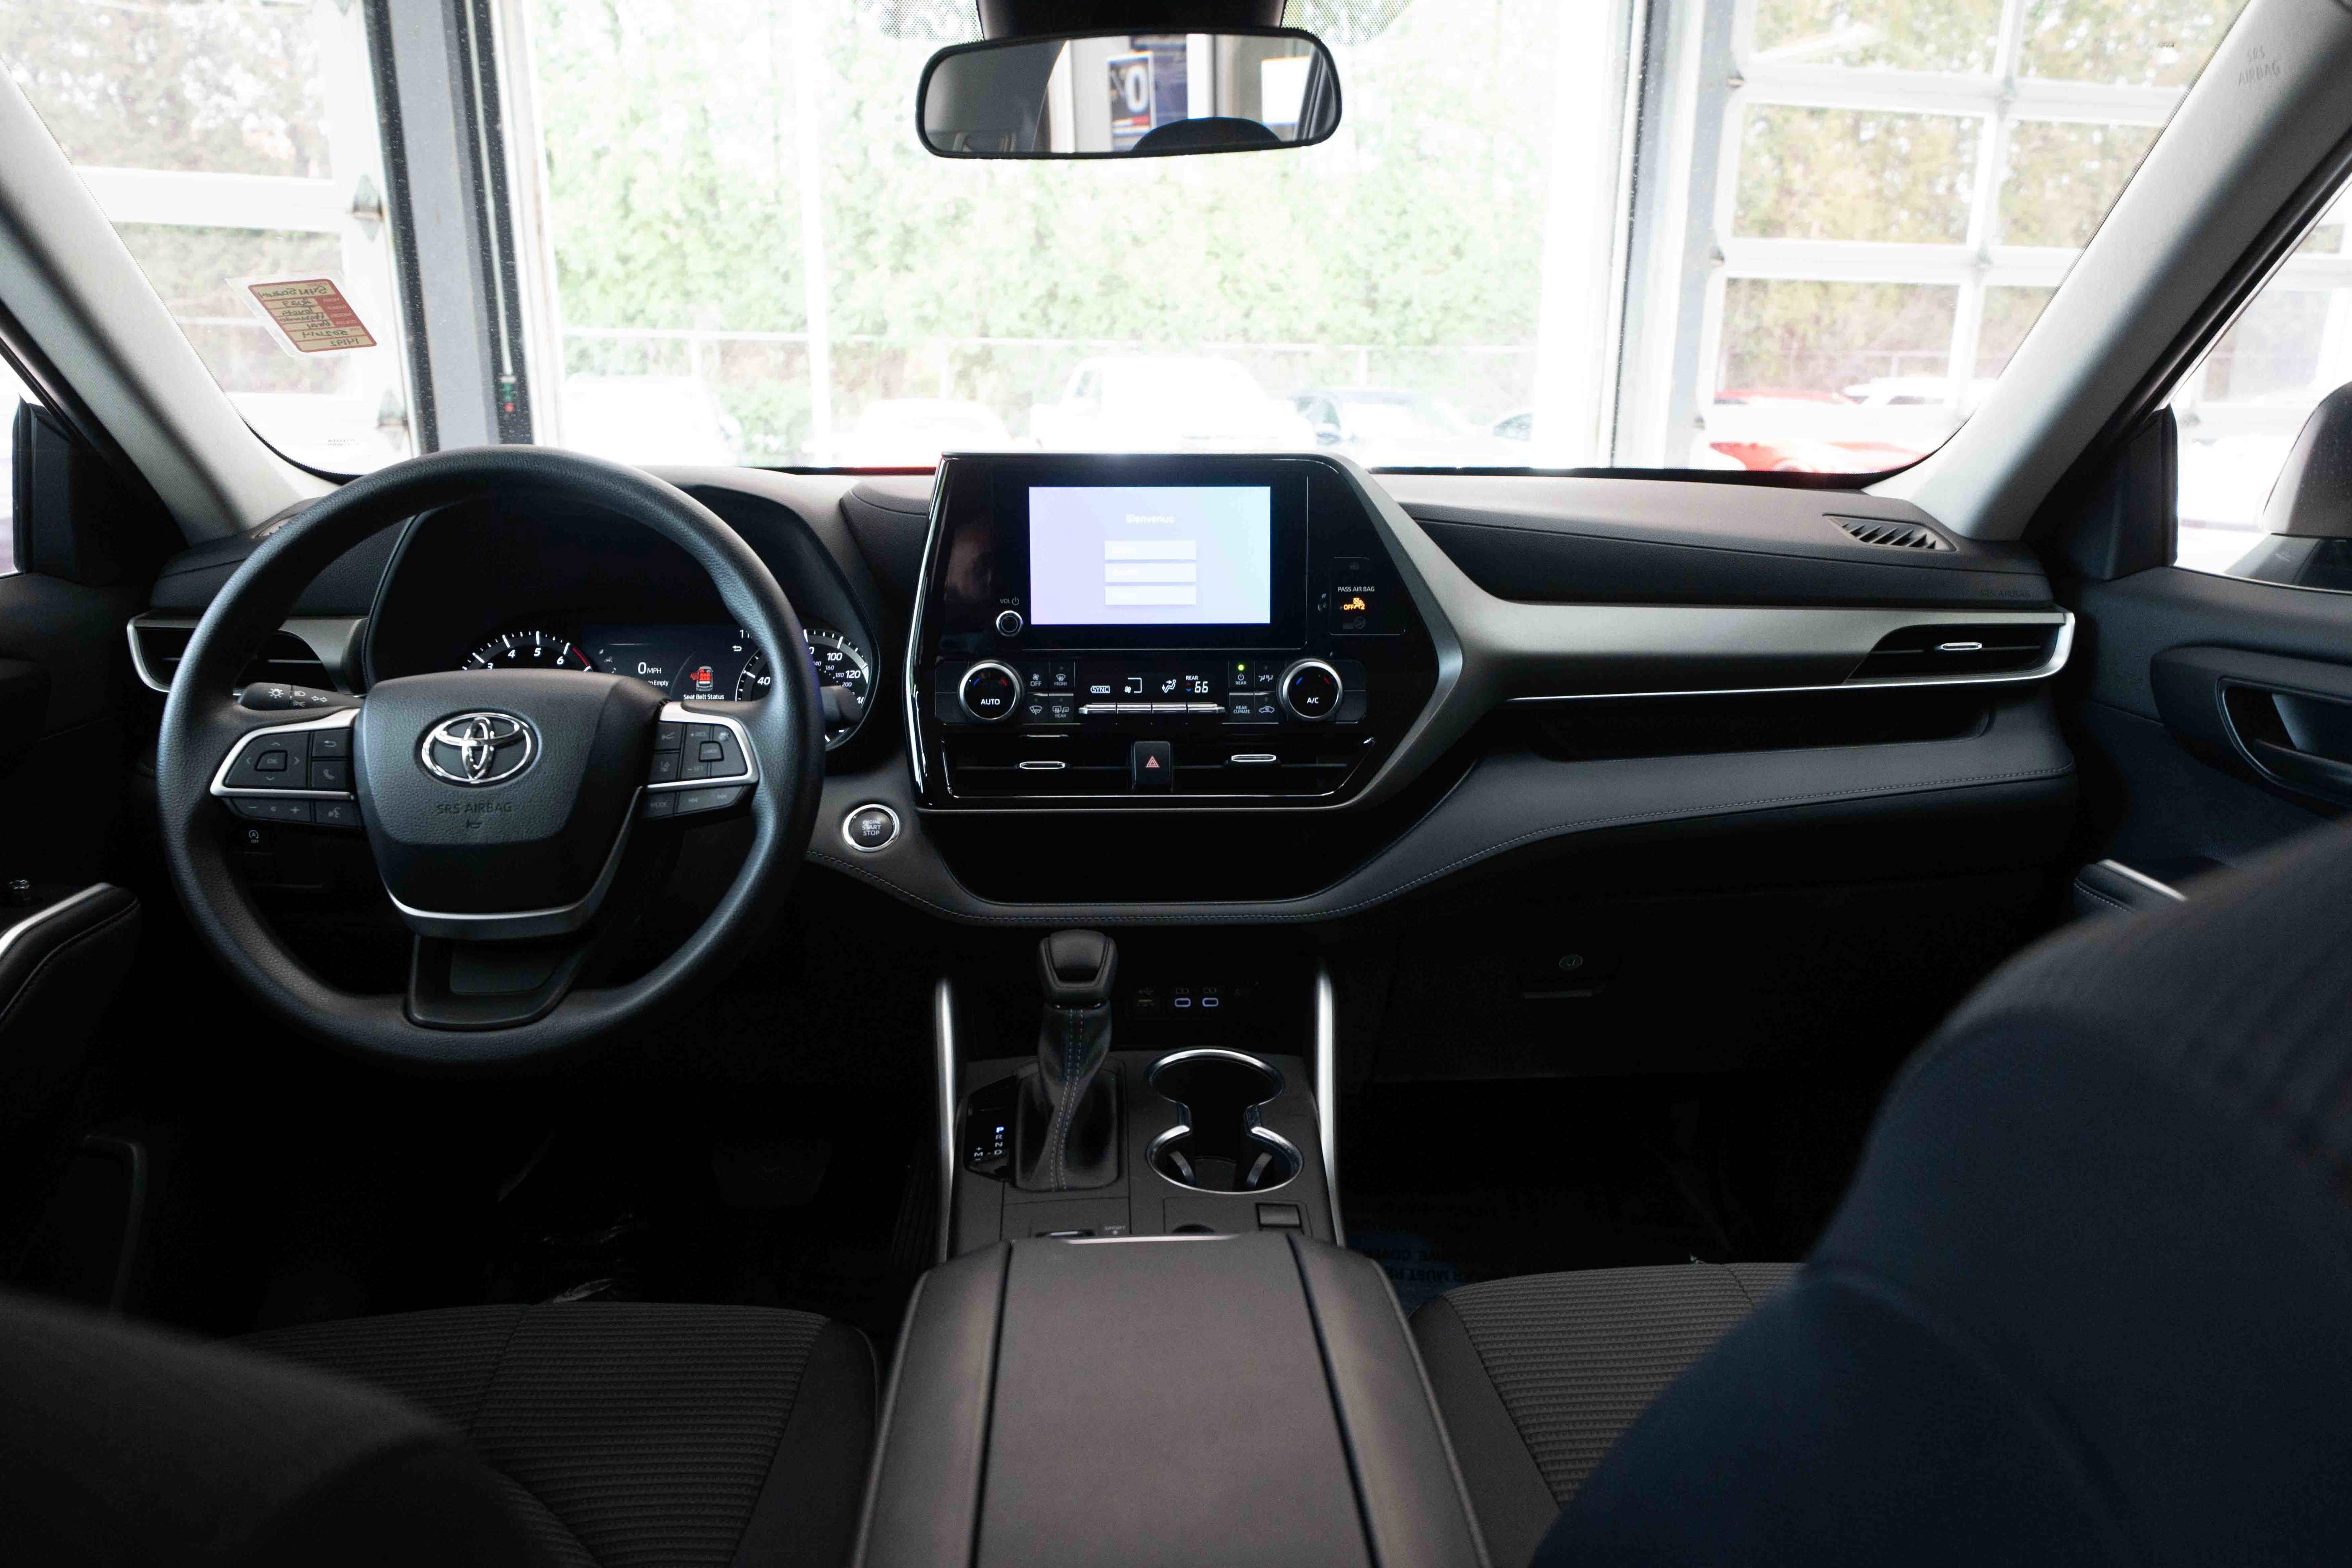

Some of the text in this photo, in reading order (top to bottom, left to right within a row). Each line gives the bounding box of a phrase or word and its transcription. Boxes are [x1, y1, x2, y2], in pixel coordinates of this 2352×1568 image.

[508, 649, 515, 658] 4
[533, 647, 541, 657] 5
[557, 656, 564, 665] 6
[827, 653, 843, 661] 100
[638, 662, 647, 674] 0
[845, 670, 861, 679] 120
[757, 676, 771, 685] 40
[1194, 681, 1208, 693] 66
[436, 802, 512, 815] SRS AIRBAG
